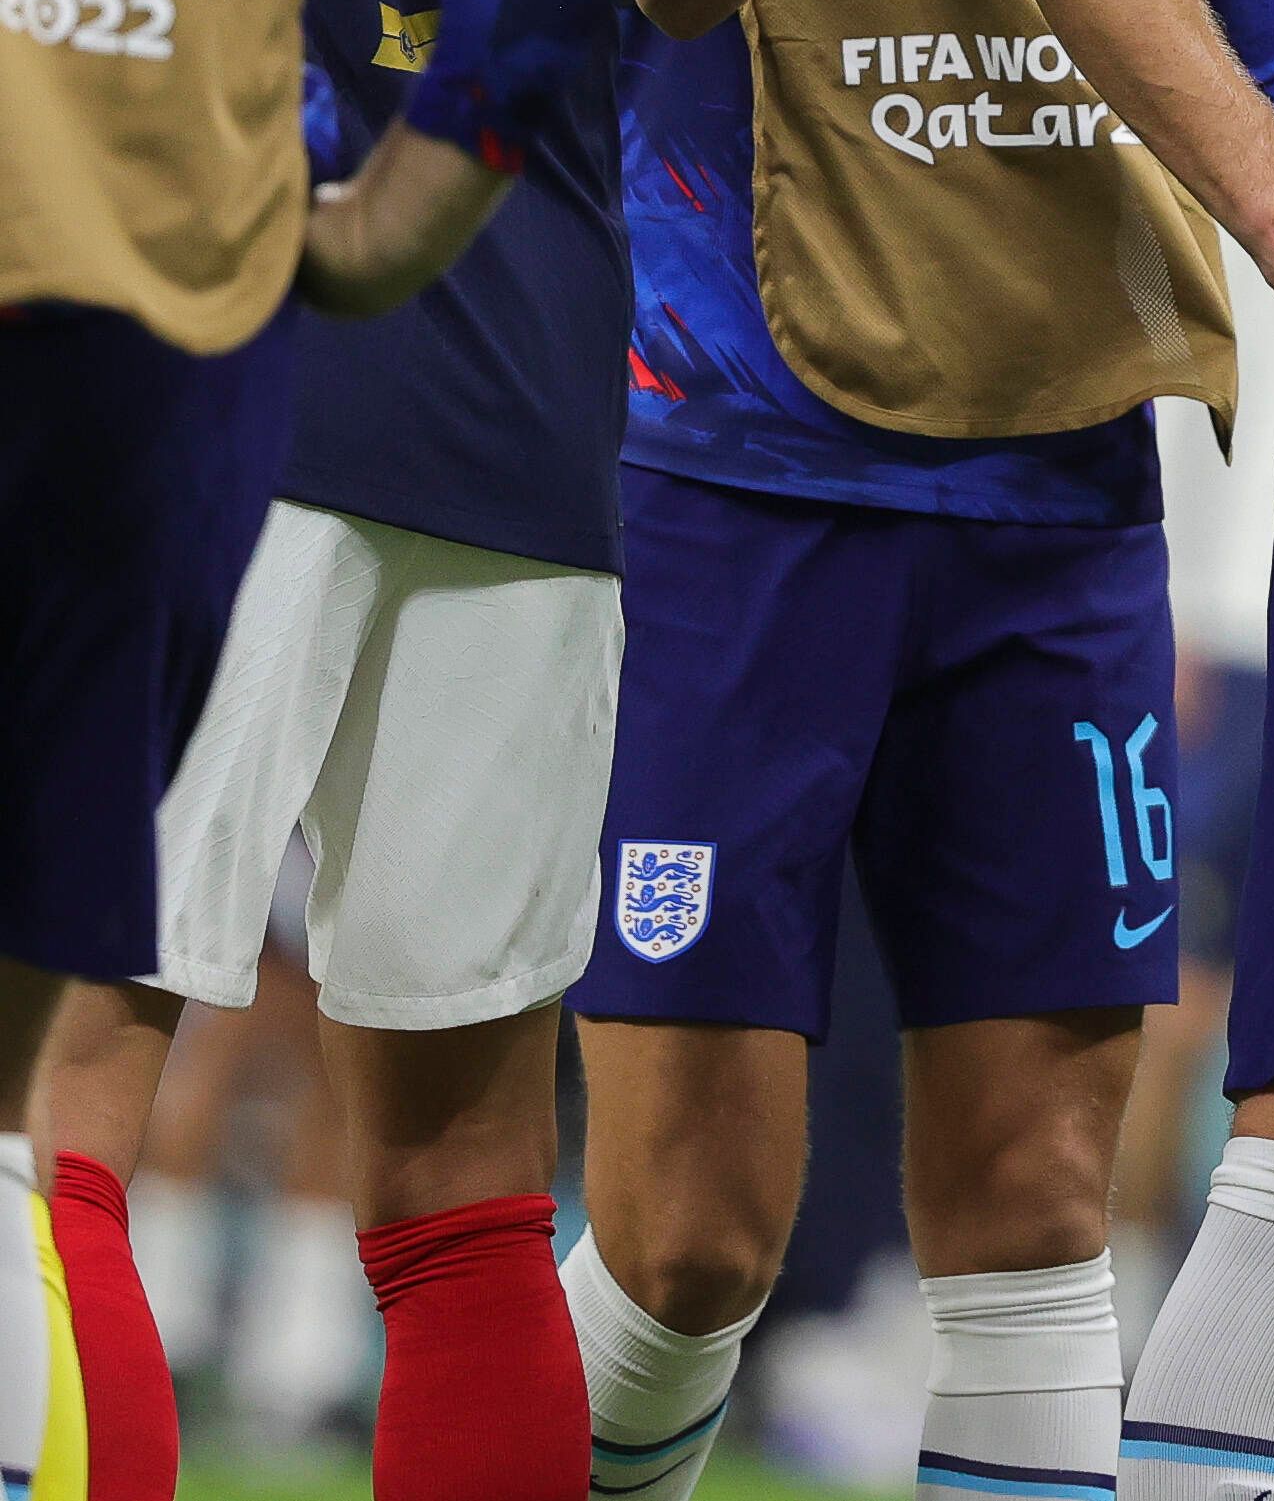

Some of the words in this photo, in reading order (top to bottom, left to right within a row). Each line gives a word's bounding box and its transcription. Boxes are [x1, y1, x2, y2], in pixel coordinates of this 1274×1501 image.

[842, 33, 974, 86] FIFA
[974, 33, 1087, 84] WO
[1073, 711, 1175, 888] 16
